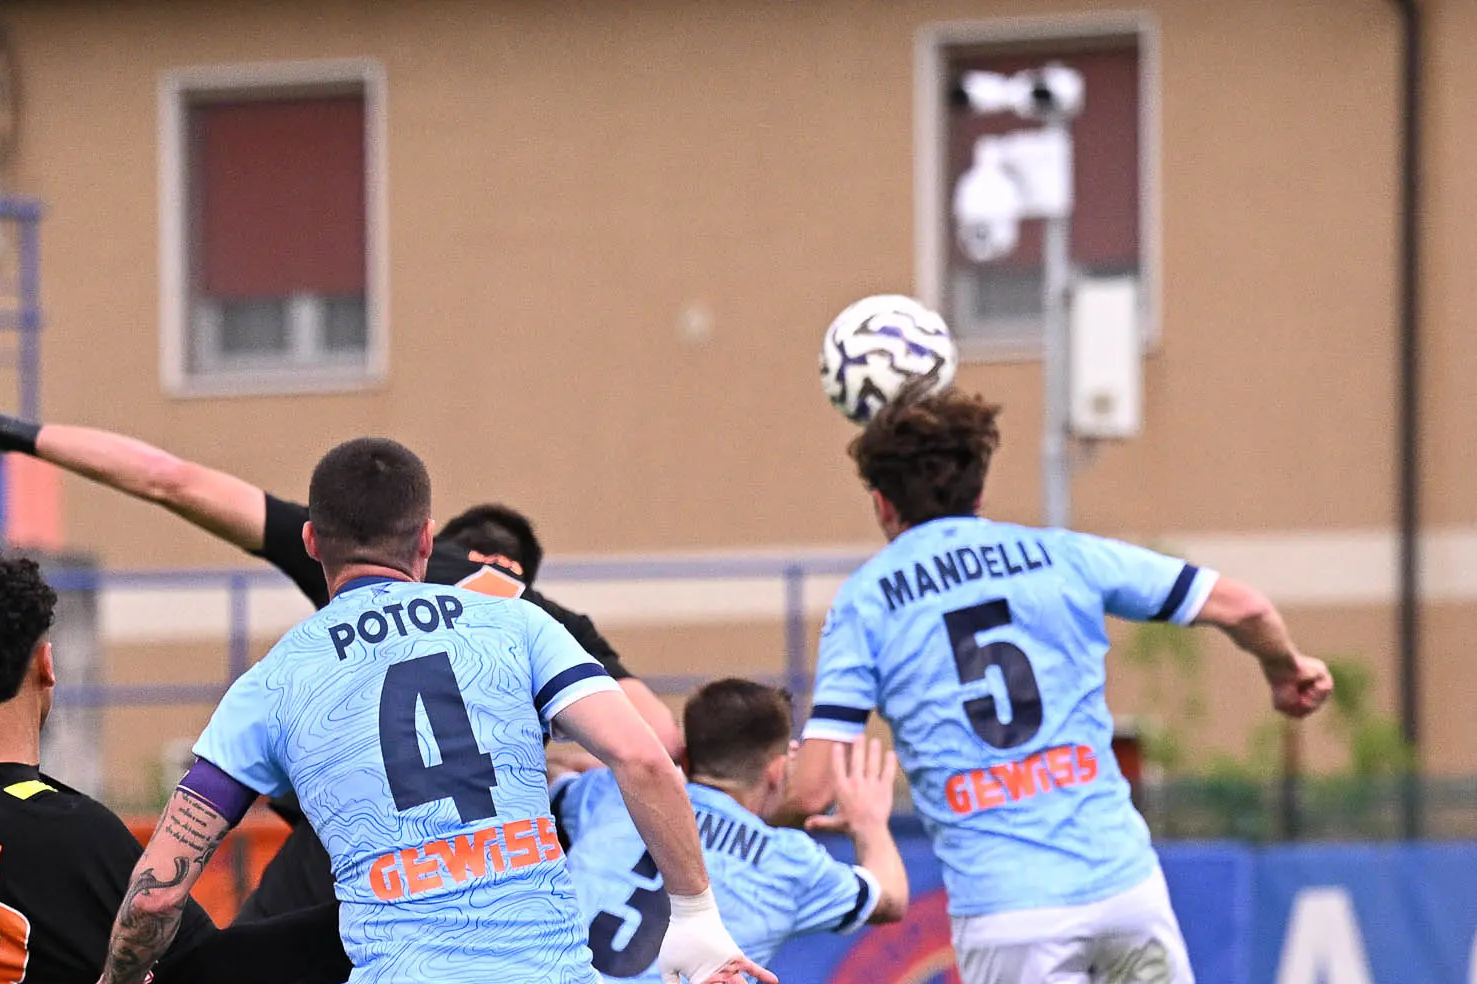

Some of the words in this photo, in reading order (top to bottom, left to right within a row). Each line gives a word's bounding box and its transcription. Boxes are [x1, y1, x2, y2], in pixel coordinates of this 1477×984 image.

[878, 540, 1053, 612] MANDELLI
[328, 595, 464, 661] POTOP
[942, 597, 1045, 750] 5
[378, 650, 498, 824] 4
[695, 811, 769, 867] NINI
[589, 850, 671, 978] 3
